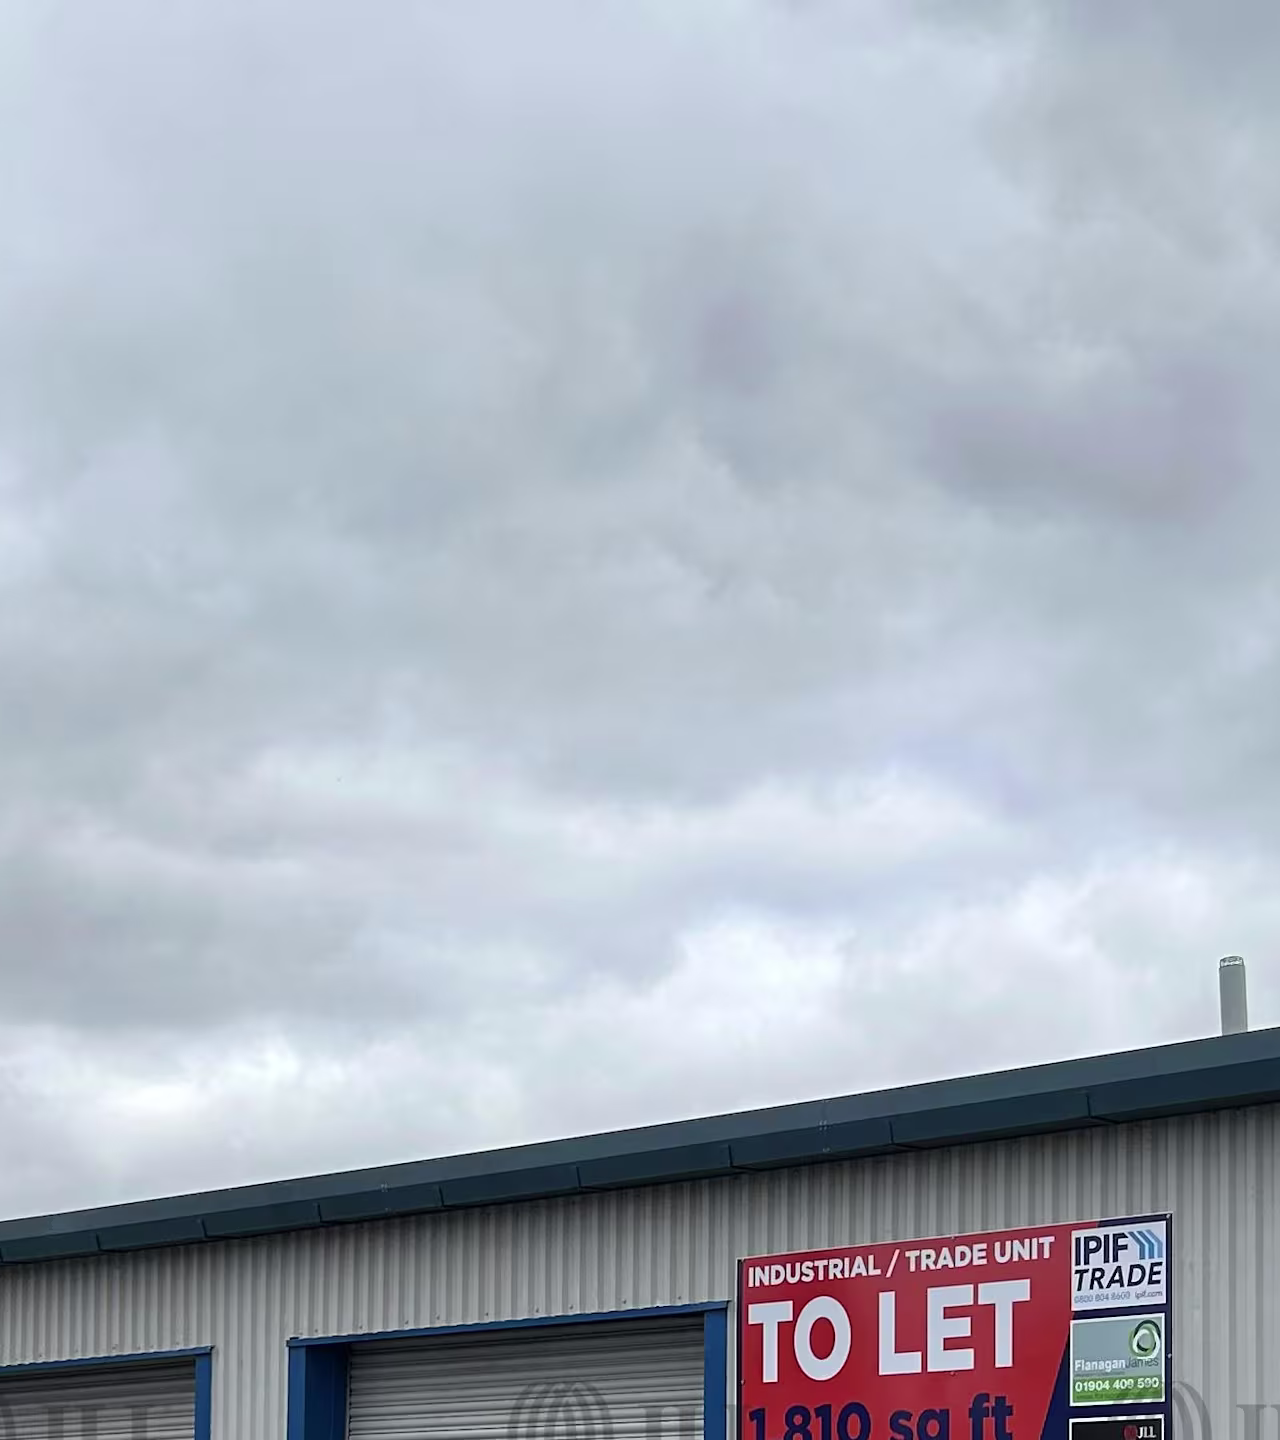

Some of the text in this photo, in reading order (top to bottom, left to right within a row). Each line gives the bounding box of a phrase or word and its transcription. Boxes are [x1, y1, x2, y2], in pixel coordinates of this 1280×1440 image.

[748, 1236, 1055, 1287] INDUSTRIAL / TRADE UNIT
[1075, 1232, 1129, 1266] IPIF
[1074, 1262, 1163, 1292] TRADE
[748, 1278, 1030, 1383] TO LET
[1075, 1380, 1110, 1392] 01904
[1136, 1426, 1157, 1439] JLL
